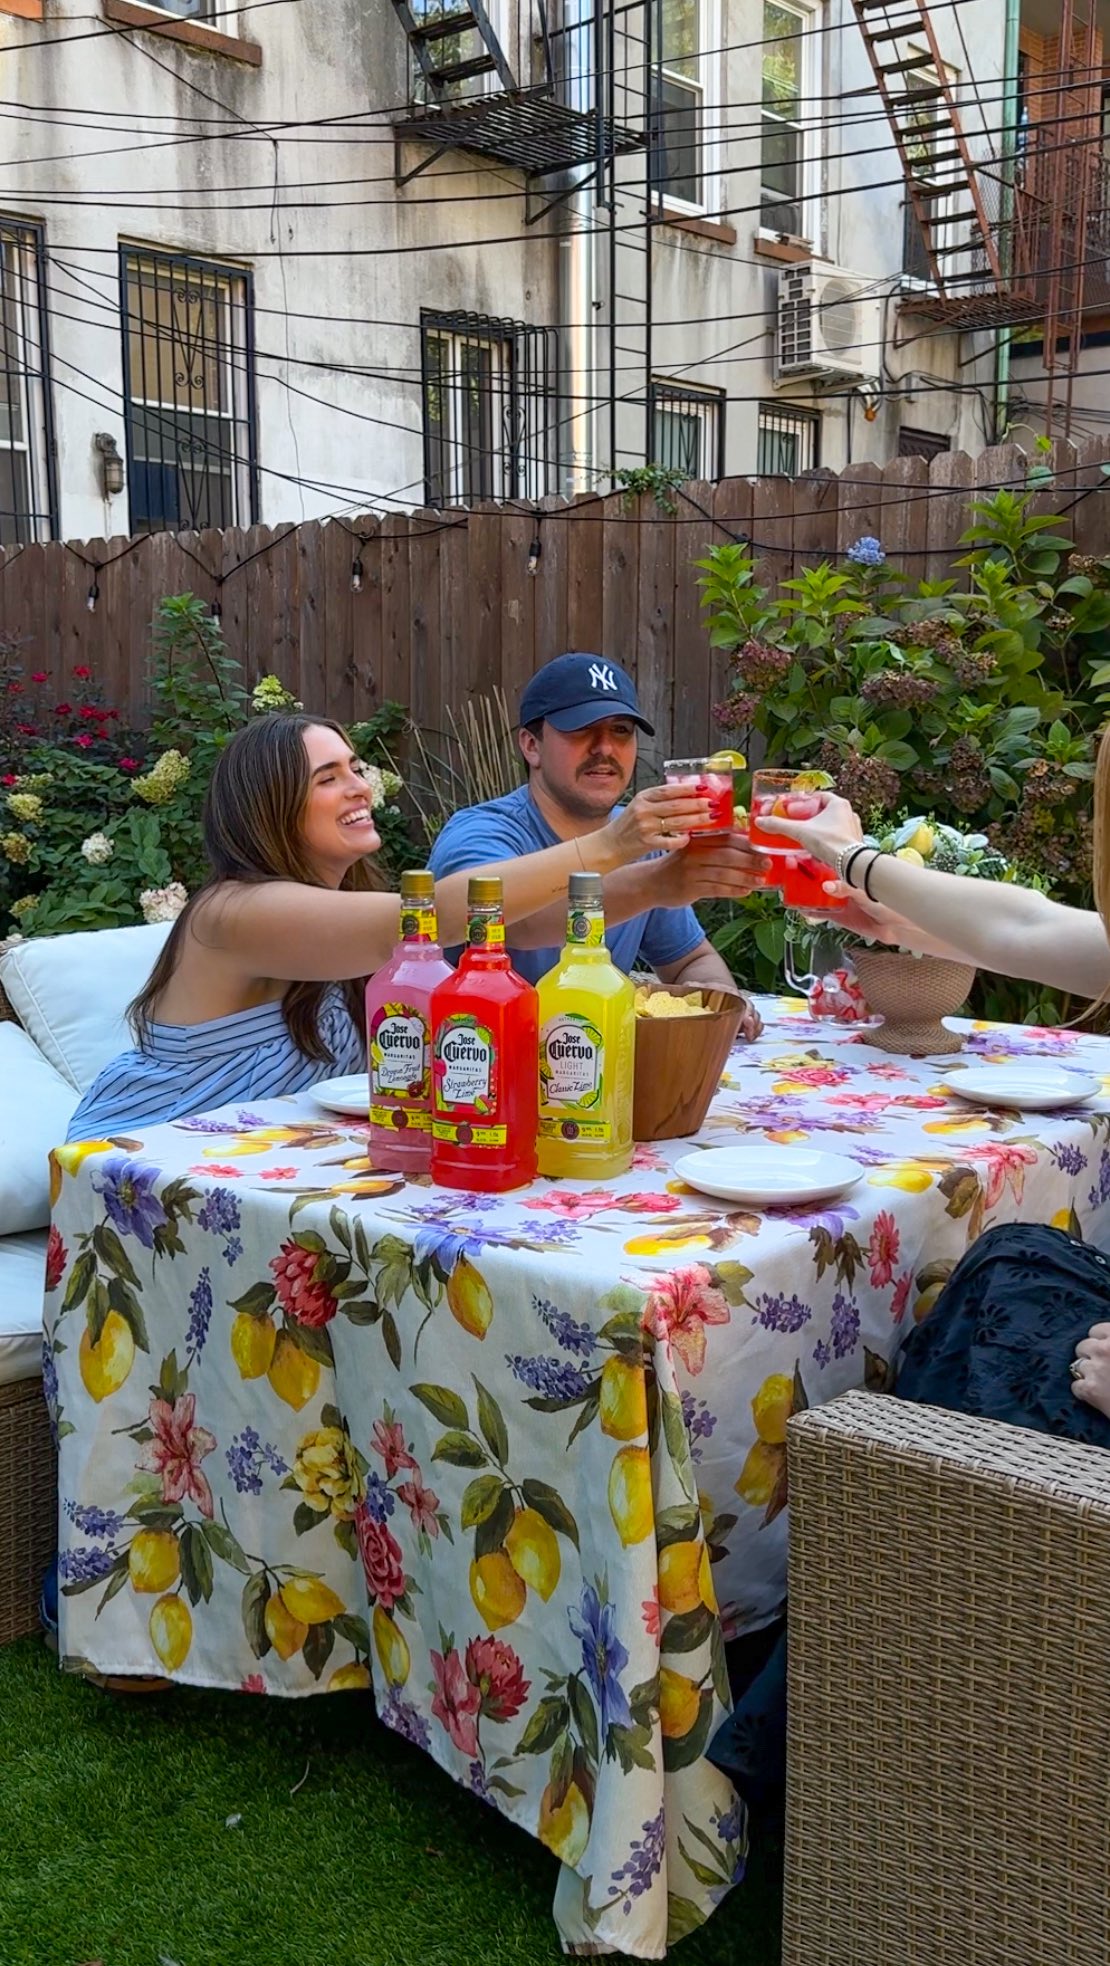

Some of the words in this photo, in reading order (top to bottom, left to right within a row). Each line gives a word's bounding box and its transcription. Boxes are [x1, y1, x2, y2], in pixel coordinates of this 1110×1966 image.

[588, 663, 618, 691] NY
[391, 1022, 408, 1034] Jose
[379, 1031, 420, 1049] Cuervo
[458, 1034, 475, 1045] Jose
[562, 1033, 581, 1044] Jose
[444, 1041, 487, 1062] Cuervo
[549, 1040, 592, 1060] Cuervo
[560, 1061, 583, 1070] LIGHT
[444, 1077, 487, 1092] Strawberry
